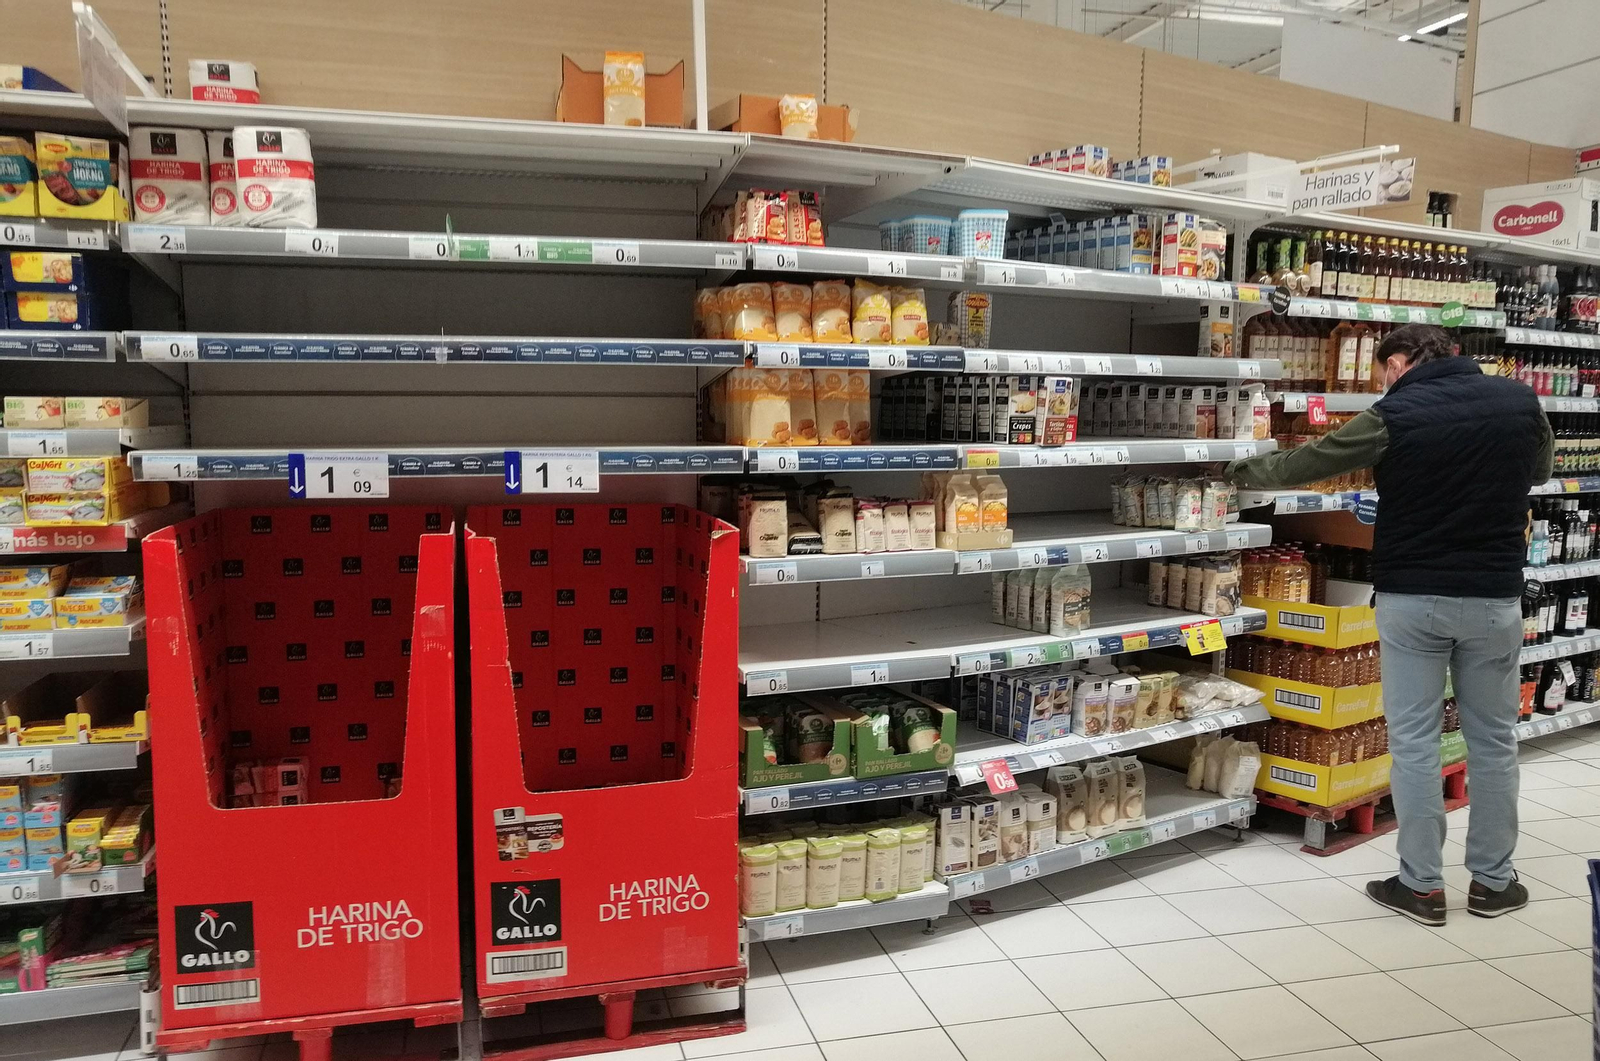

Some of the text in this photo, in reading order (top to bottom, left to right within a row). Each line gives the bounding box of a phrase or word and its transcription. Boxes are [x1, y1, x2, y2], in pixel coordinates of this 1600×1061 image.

[255, 159, 287, 168] HARINA
[266, 166, 291, 174] TRIGO
[1305, 169, 1375, 192] Harinas y
[1291, 187, 1372, 213] pan rallado
[1498, 210, 1558, 228] Carbonell
[76, 236, 98, 246] 1-12
[159, 234, 185, 251] 2,38
[312, 238, 335, 254] 0,71
[615, 248, 637, 263] 0,69
[1012, 422, 1031, 431] Crepes
[38, 439, 64, 455] 1,65
[778, 456, 797, 470] 0,73
[320, 466, 334, 493] 1
[536, 462, 548, 488] 1
[567, 476, 583, 488] 14
[354, 481, 371, 493] 09
[14, 531, 95, 549] más bajo
[777, 569, 795, 582] 0,90
[24, 641, 49, 656] 1,57
[865, 765, 879, 774] AJO
[753, 774, 768, 783] AJO
[994, 773, 1006, 790] 0
[609, 874, 700, 901] HARINA
[308, 899, 413, 927] HARINA
[599, 891, 710, 922] DE TRIGO
[297, 918, 424, 949] DE TRIGO
[496, 923, 557, 941] GALLO
[180, 949, 250, 968] GALLO
